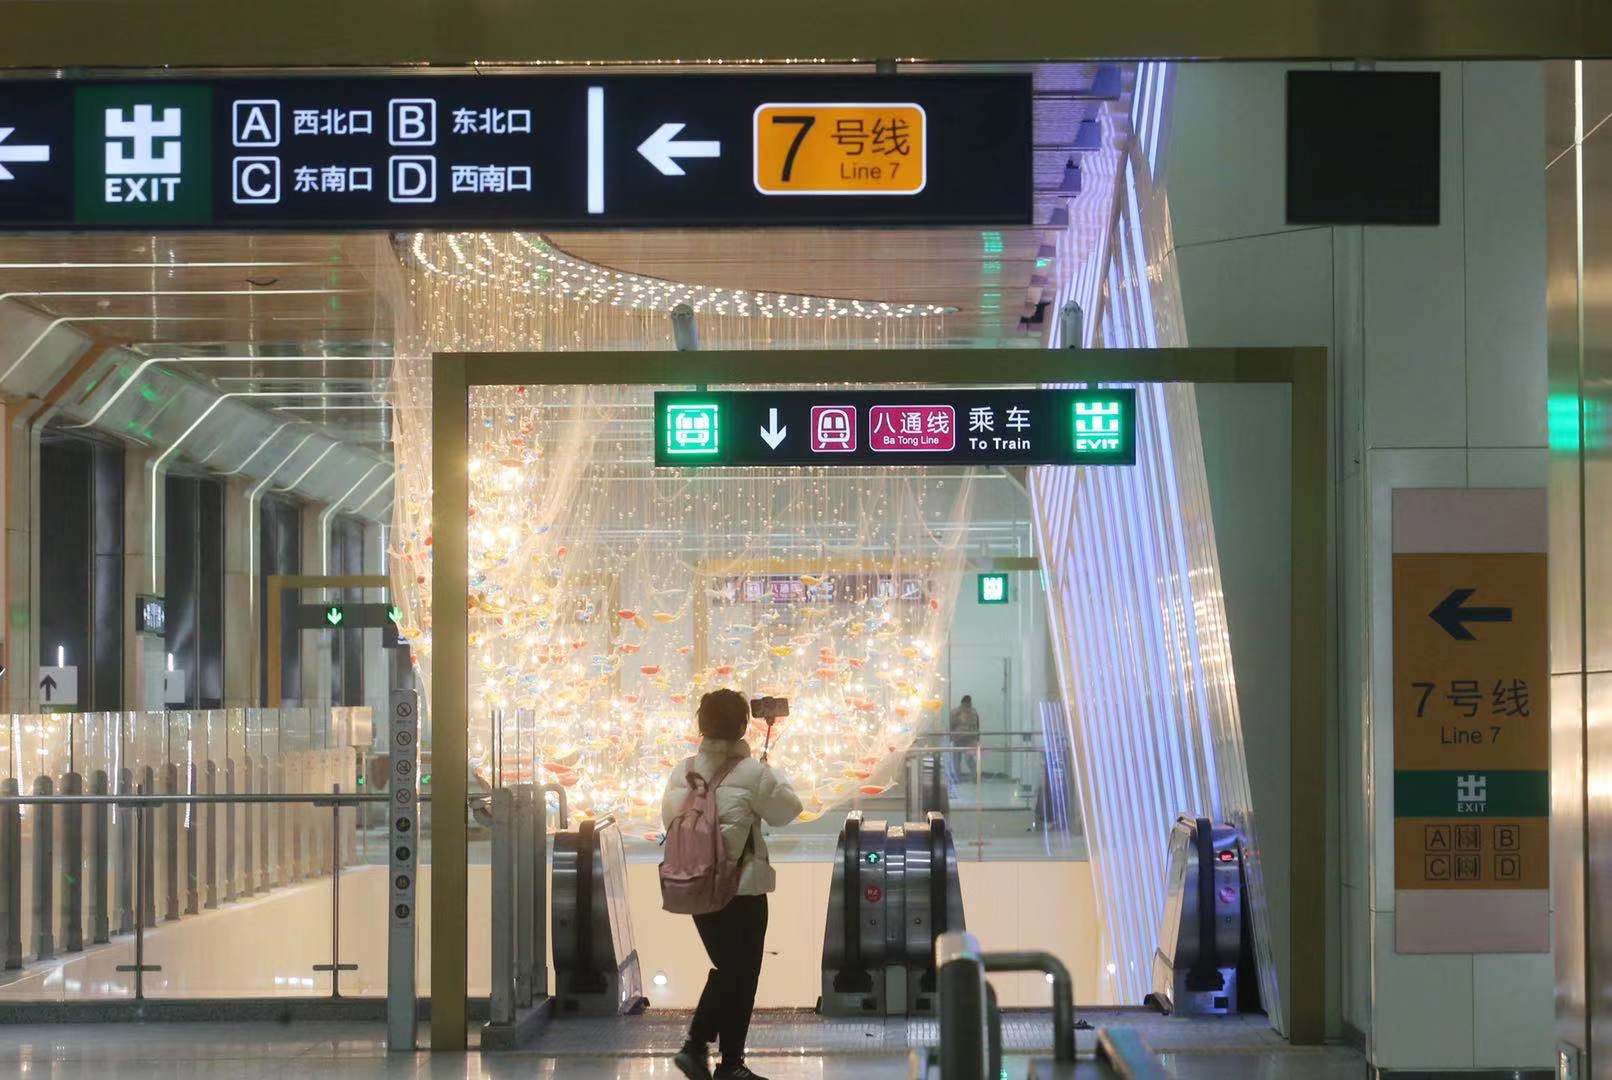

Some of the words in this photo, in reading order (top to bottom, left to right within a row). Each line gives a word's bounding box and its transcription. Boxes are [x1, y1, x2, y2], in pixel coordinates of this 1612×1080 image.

[241, 106, 272, 140] A
[293, 108, 373, 135] 西北口
[400, 106, 425, 139] B
[452, 107, 531, 135] 东北口
[241, 163, 271, 196] C
[294, 165, 372, 192] 东南口
[399, 163, 427, 196] D
[451, 165, 532, 192] 西南口
[840, 162, 882, 180] Line
[888, 162, 900, 180] 7
[105, 177, 181, 203] EXIT
[873, 411, 950, 434] 八通线
[968, 406, 1031, 433] 乘车
[883, 435, 896, 445] Ba
[897, 435, 919, 448] Tong
[921, 435, 940, 445] Line
[968, 437, 988, 450] To
[992, 437, 1031, 450] Train
[1441, 726, 1482, 745] Line
[1489, 726, 1502, 744] 7
[1457, 803, 1487, 813] EXIT
[1430, 829, 1447, 848] A
[1500, 829, 1514, 847] B
[1429, 858, 1446, 877] C
[1500, 858, 1516, 877] D
